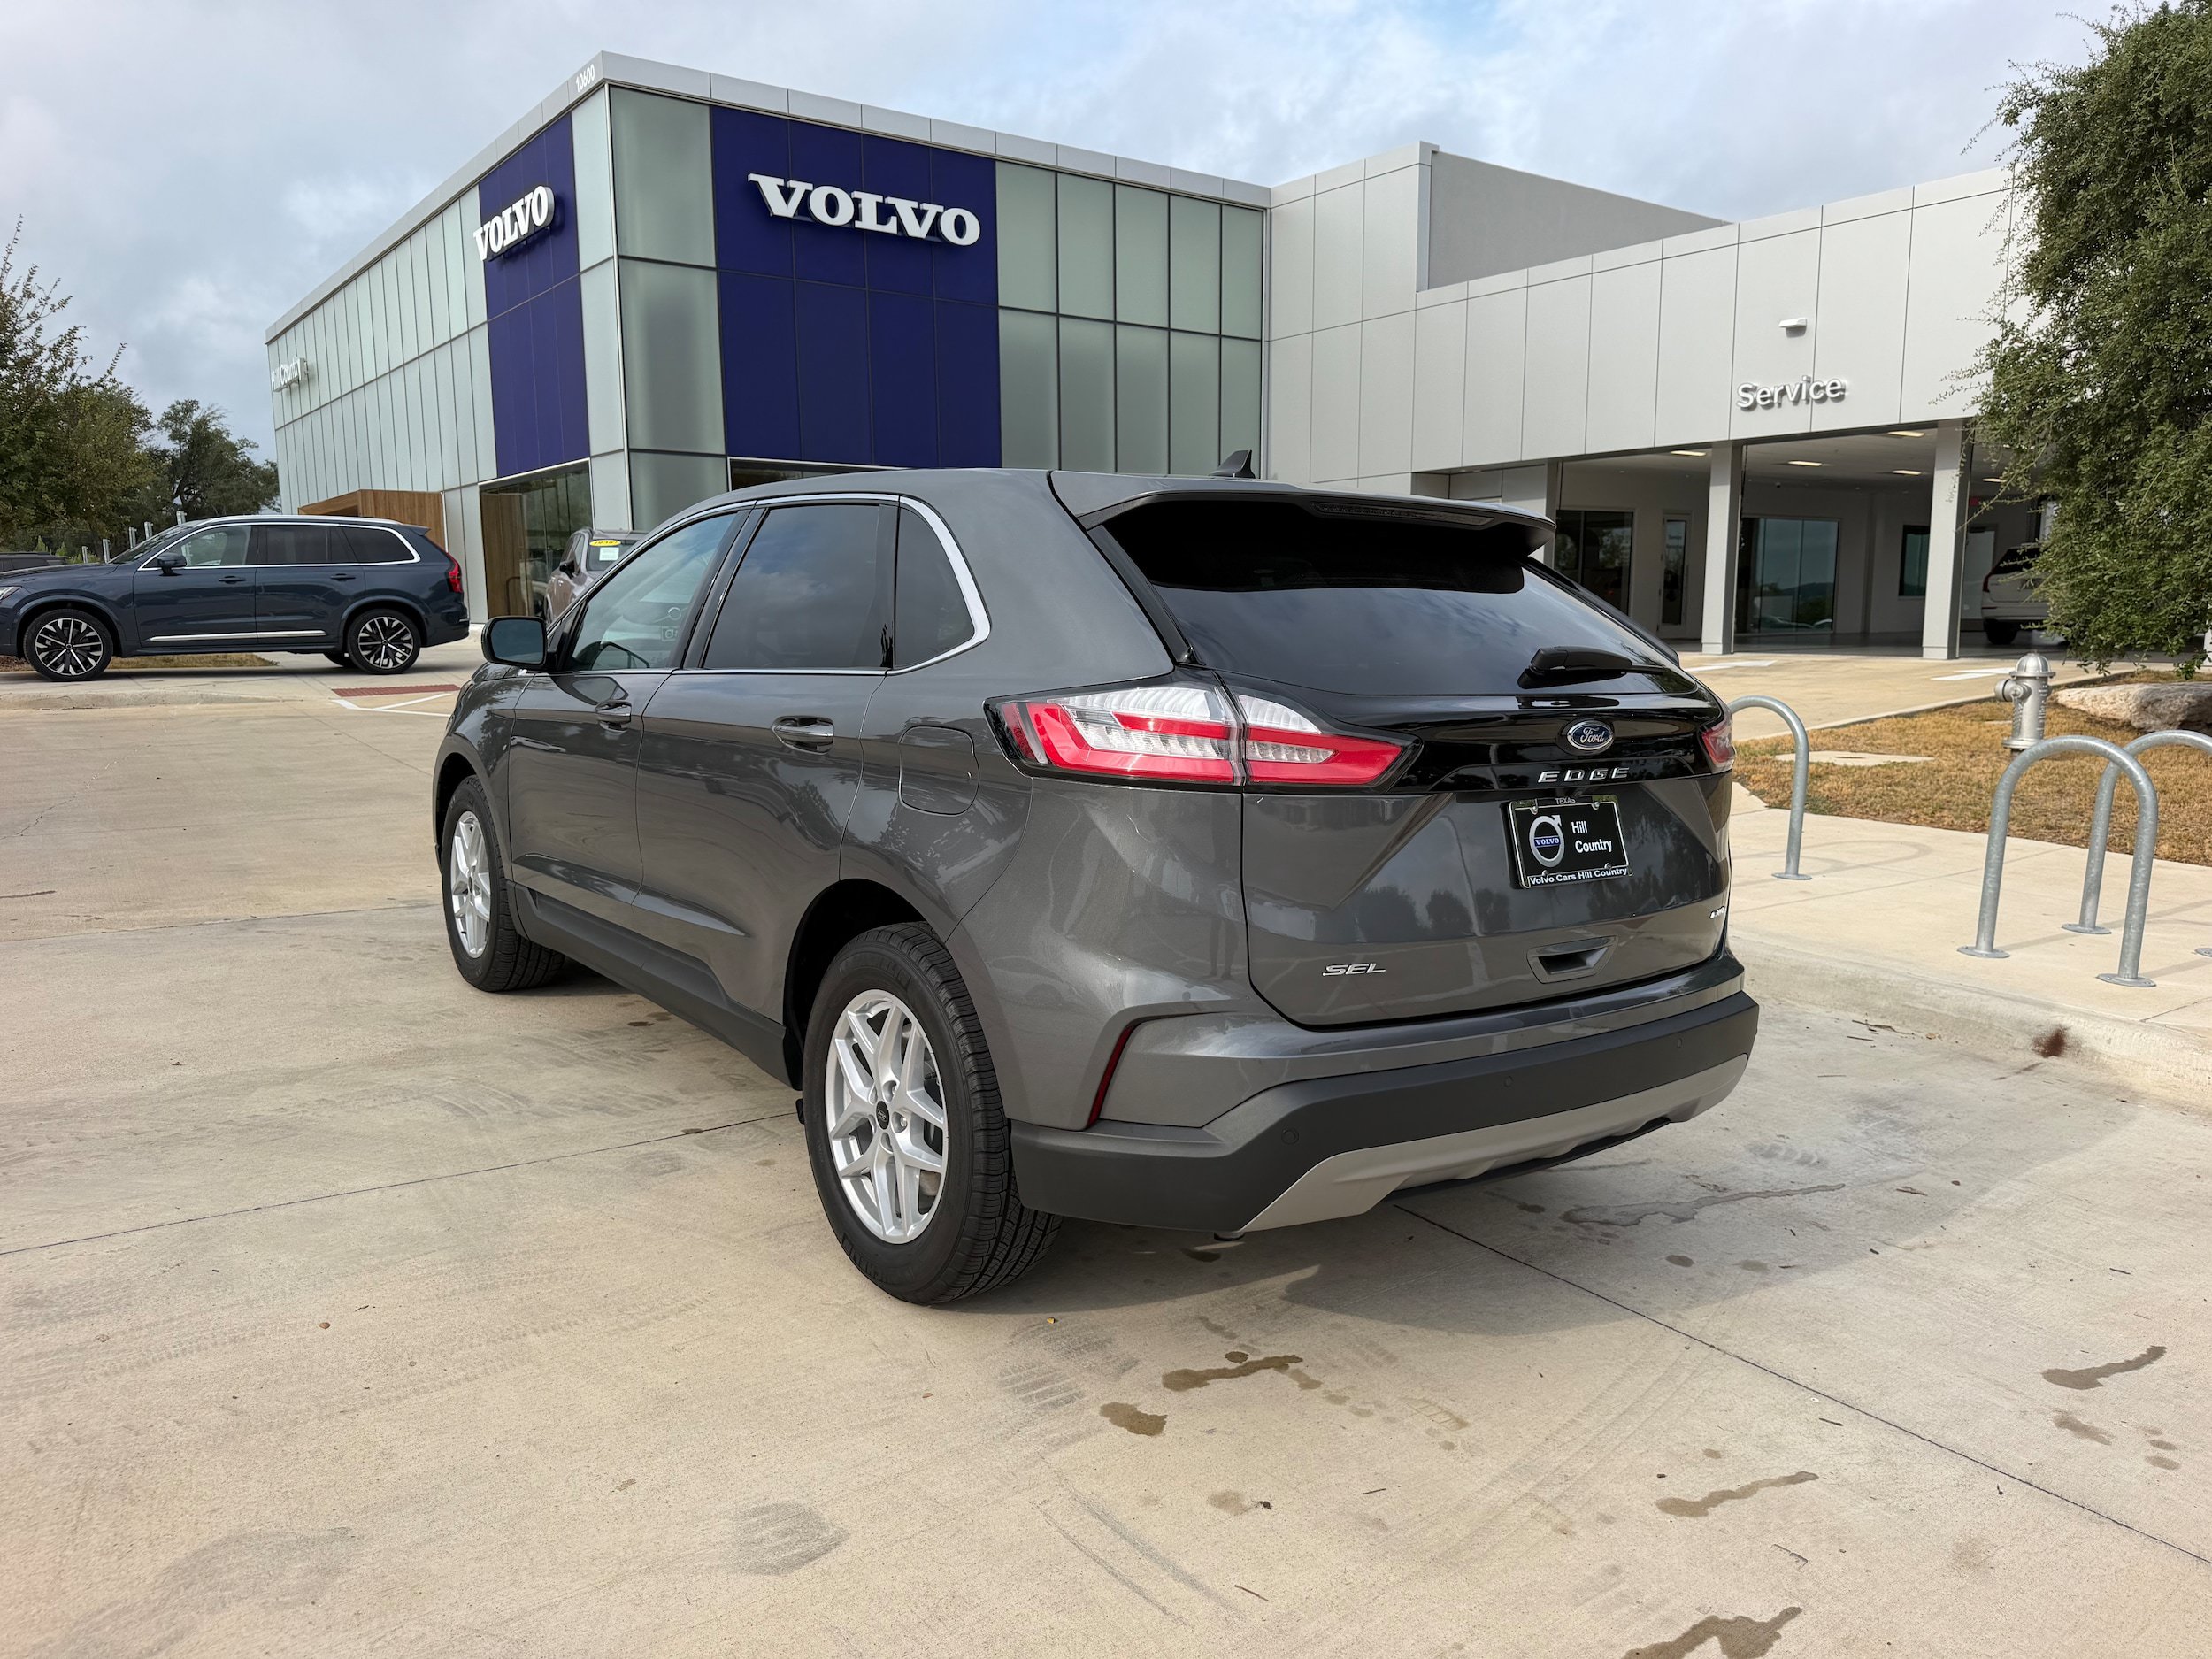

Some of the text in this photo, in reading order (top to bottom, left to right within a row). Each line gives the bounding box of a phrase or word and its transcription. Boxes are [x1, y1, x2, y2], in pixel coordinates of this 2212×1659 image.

[576, 64, 595, 93] 10600
[748, 173, 980, 246] VOLVO
[472, 185, 550, 261] VOLVO
[1736, 375, 1844, 408] Service
[1579, 726, 1605, 743] Ford
[1538, 767, 1630, 783] EDGE
[1571, 820, 1588, 833] Hill
[1535, 837, 1560, 846] VOLVO
[1575, 839, 1612, 853] Country
[1529, 868, 1628, 885] Volvo Cars Hill Country
[1323, 963, 1386, 976] SEL
